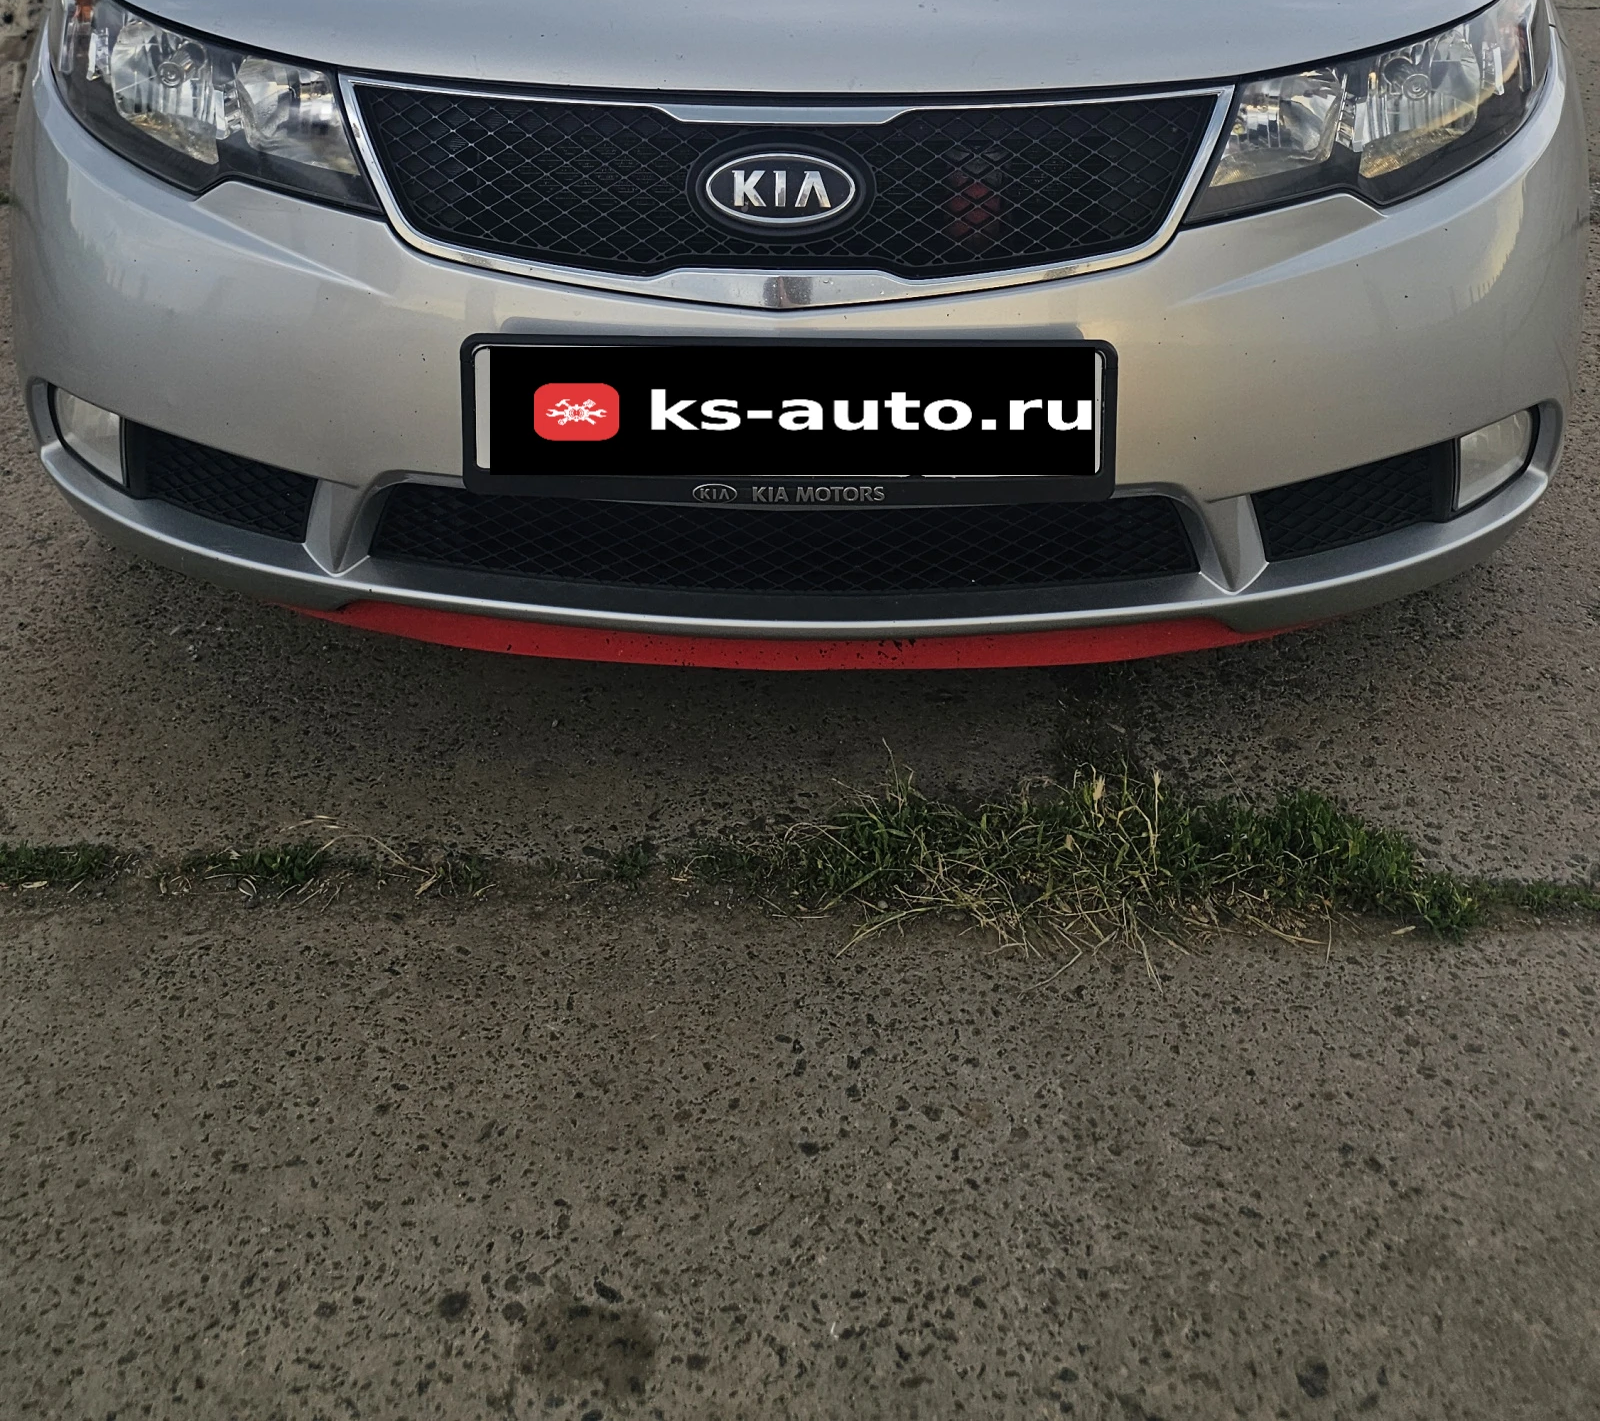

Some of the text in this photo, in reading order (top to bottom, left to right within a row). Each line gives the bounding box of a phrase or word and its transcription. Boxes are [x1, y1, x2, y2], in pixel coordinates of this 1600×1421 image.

[732, 170, 832, 208] KIA
[700, 488, 730, 500] KIA
[752, 486, 885, 502] KIA MOTORS
